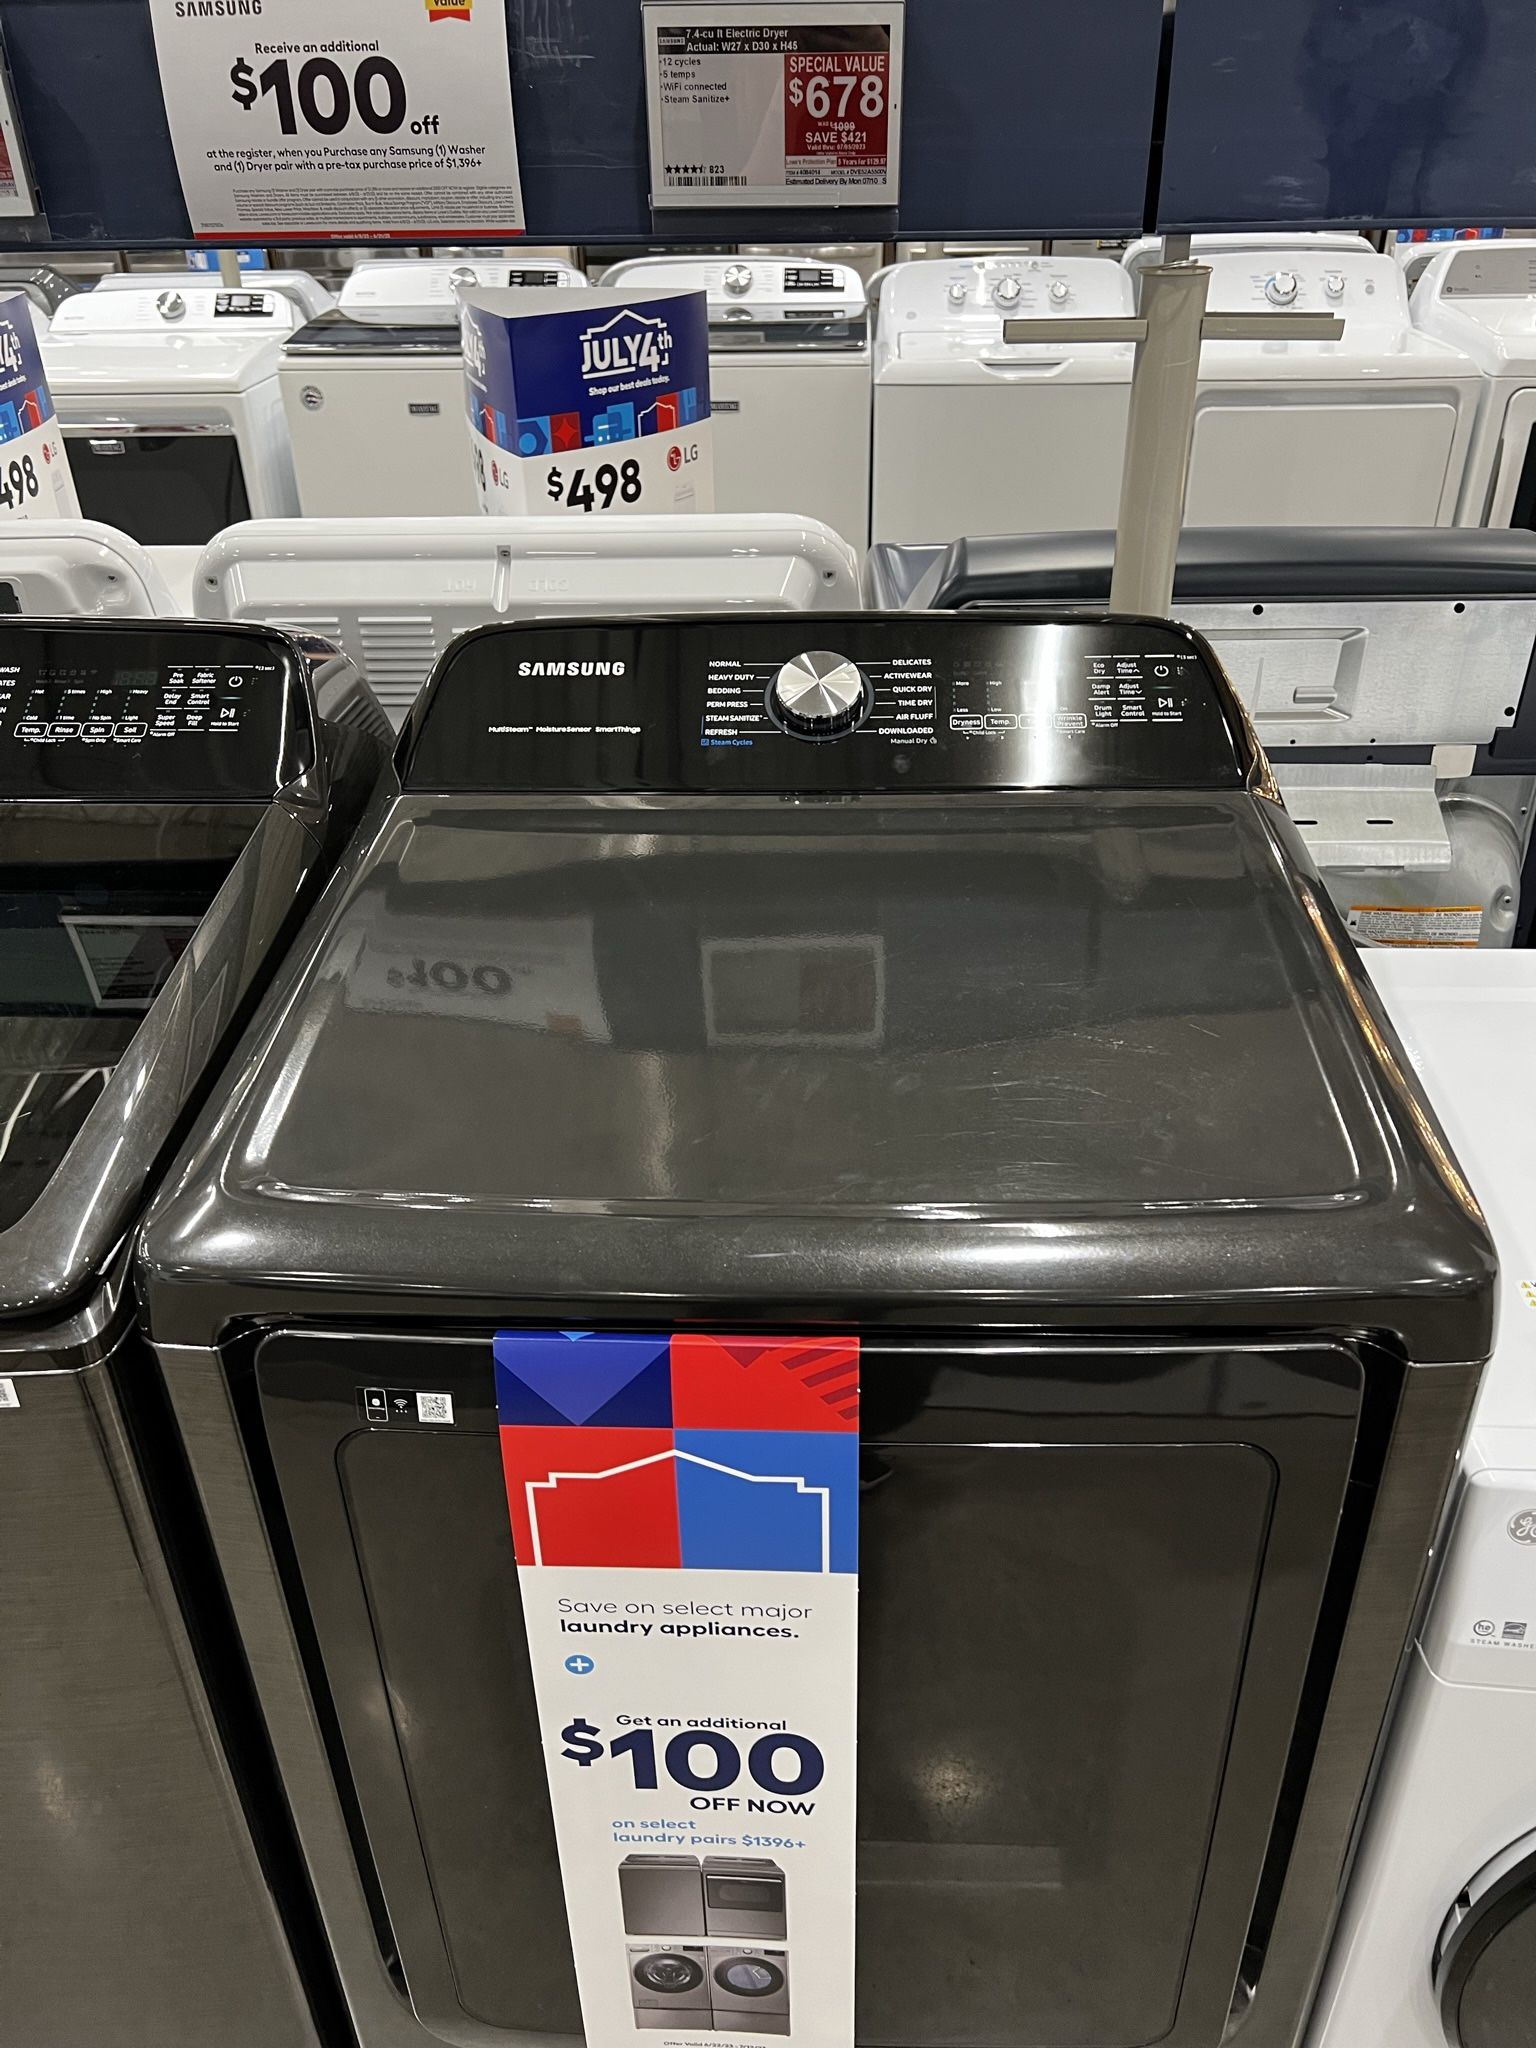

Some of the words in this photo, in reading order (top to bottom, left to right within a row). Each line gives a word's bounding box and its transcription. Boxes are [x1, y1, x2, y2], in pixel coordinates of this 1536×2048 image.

[175, 0, 262, 17] SAMSUNG
[686, 29, 714, 39] 7.4-cu
[716, 29, 723, 38] ft
[725, 28, 761, 38] Electric
[763, 28, 788, 40] Dryer
[255, 42, 300, 54] Receive
[303, 44, 317, 53] an
[320, 40, 379, 52] additional
[686, 42, 720, 52] Actual:
[721, 42, 741, 51] W27
[744, 43, 750, 51] x
[752, 41, 770, 51] D30
[780, 41, 798, 51] H45
[663, 57, 672, 66] 12
[674, 57, 701, 67] cycles
[789, 56, 841, 73] SPECIAL
[845, 56, 885, 72] VALUE
[670, 71, 696, 80] temps
[663, 82, 682, 91] WiFi
[684, 82, 727, 91] connected
[230, 56, 406, 135] $100
[664, 95, 690, 103] Steam
[692, 94, 730, 103] Sanitize+
[789, 75, 884, 118] $678
[410, 115, 439, 135] off
[805, 132, 838, 143] SAVE
[841, 132, 867, 143] $421
[206, 150, 217, 158] at
[218, 149, 234, 158] the
[236, 148, 276, 160] register,
[277, 147, 303, 157] when
[305, 149, 322, 159] you
[324, 147, 368, 158] Purchase
[370, 147, 387, 158] any
[389, 145, 434, 157] Samsung
[435, 144, 447, 157] (1)
[449, 144, 486, 155] Washer
[807, 143, 821, 151] Valid
[214, 163, 232, 172] and
[234, 161, 245, 173] (1)
[247, 161, 273, 172] Dryer
[275, 161, 292, 172] pair
[295, 160, 316, 170] with
[326, 159, 361, 171] pre-tax
[363, 159, 407, 171] purchase
[409, 158, 433, 170] price
[434, 158, 445, 168] of
[446, 158, 482, 169] $1,396+
[709, 165, 725, 174] 823
[588, 387, 607, 396] Shop
[608, 385, 620, 393] our
[620, 381, 635, 391] best
[635, 377, 652, 388] deals
[652, 375, 671, 384] today.
[684, 444, 699, 464] LG
[547, 458, 642, 513] $498
[518, 661, 626, 677] SAMSUNG
[892, 658, 932, 666] DELICATES
[89, 726, 105, 734] Spin
[595, 726, 641, 734] SmartThings
[732, 739, 753, 747] Cycles
[558, 1598, 617, 1614] Save
[625, 1602, 655, 1615] on
[663, 1601, 733, 1616] select
[741, 1604, 812, 1622] major
[560, 1619, 653, 1636] laundry
[660, 1621, 799, 1639] appliances.
[616, 1715, 652, 1726] Get
[657, 1717, 681, 1727] an
[687, 1716, 786, 1730] additional
[561, 1718, 824, 1796] $100
[690, 1797, 740, 1811] OFF
[747, 1798, 815, 1816] NOW
[612, 1820, 636, 1829] on
[639, 1819, 696, 1830] select
[613, 1832, 686, 1845] laundry
[691, 1834, 737, 1845] pairs
[742, 1835, 806, 1848] $1396+
